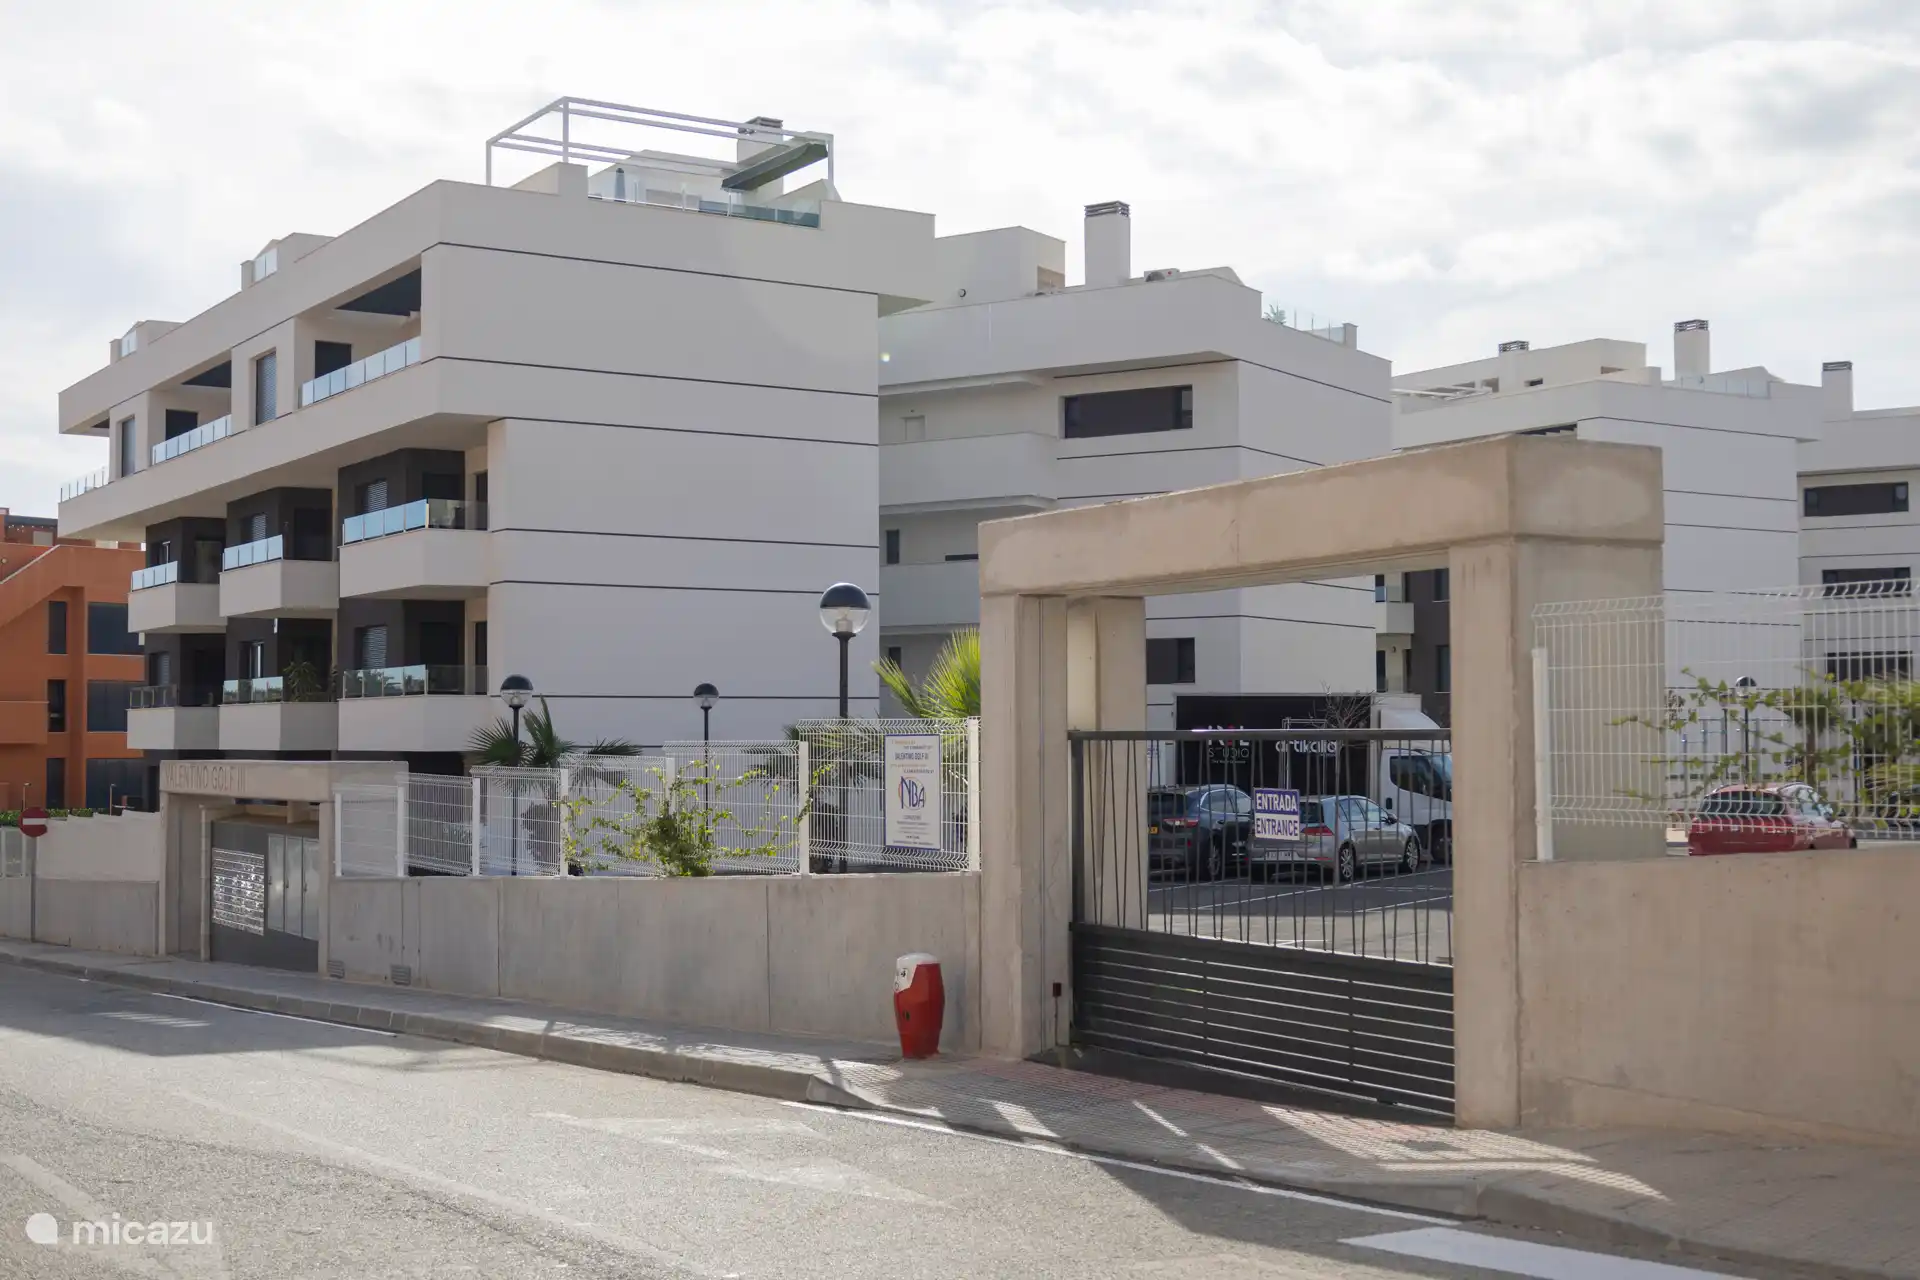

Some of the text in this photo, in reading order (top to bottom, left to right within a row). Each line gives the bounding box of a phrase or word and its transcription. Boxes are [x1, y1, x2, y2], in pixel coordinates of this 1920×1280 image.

[165, 763, 208, 790] VALENTINO
[211, 765, 236, 792] GOLF
[900, 775, 925, 809] NBA
[1256, 793, 1298, 812] ENTRADA
[1256, 818, 1298, 837] ENTRANCE
